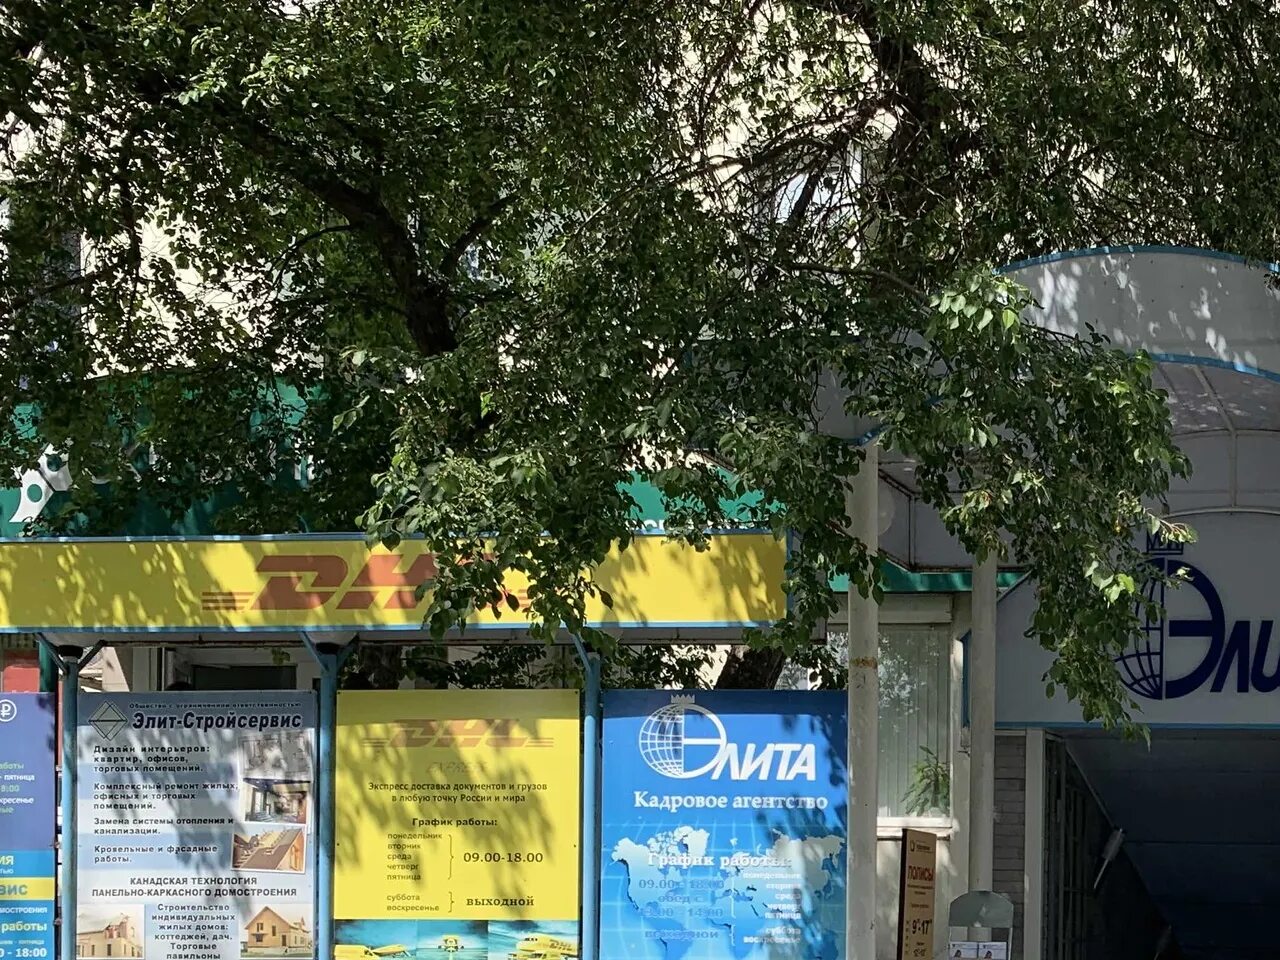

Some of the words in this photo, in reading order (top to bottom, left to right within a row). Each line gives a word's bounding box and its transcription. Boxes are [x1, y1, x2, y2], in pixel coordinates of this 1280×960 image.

[251, 554, 502, 610] DH
[132, 711, 302, 732] Элит-Стройсервис
[94, 746, 135, 754] Дизайн
[94, 756, 142, 764] квартир,
[148, 755, 189, 763] офисов,
[143, 764, 203, 773] помещений.
[94, 782, 161, 791] Комплексный
[369, 783, 408, 791] Экспресс
[411, 783, 450, 791] доставка
[453, 783, 506, 791] документов
[518, 783, 547, 792] грузов
[94, 792, 139, 800] офисных
[400, 795, 430, 803] любую
[433, 795, 457, 803] точку
[461, 794, 491, 802] России
[503, 795, 525, 803] мира
[94, 802, 156, 810] помещений.
[634, 791, 728, 812] Кадровое
[733, 795, 828, 809] агентство
[412, 818, 452, 827] График
[456, 818, 498, 827] работы:
[167, 845, 217, 853] фасадные
[94, 855, 132, 864] работы.
[464, 852, 543, 863] 09.00-18.00
[648, 854, 714, 869] График
[130, 877, 188, 885] КАНАДСКАЯ
[192, 877, 257, 885] ТЕХНОЛОГИЯ
[92, 888, 211, 897] ПАНЕЛЬНО-КАРКАСНОГО
[214, 888, 297, 897] ДОМОСТРОЕНИЯ
[467, 896, 534, 907] выходной
[158, 903, 230, 911] Строительство
[152, 914, 235, 922] индивидуальных
[2, 921, 47, 933] работы
[16, 948, 47, 957] 18:00
